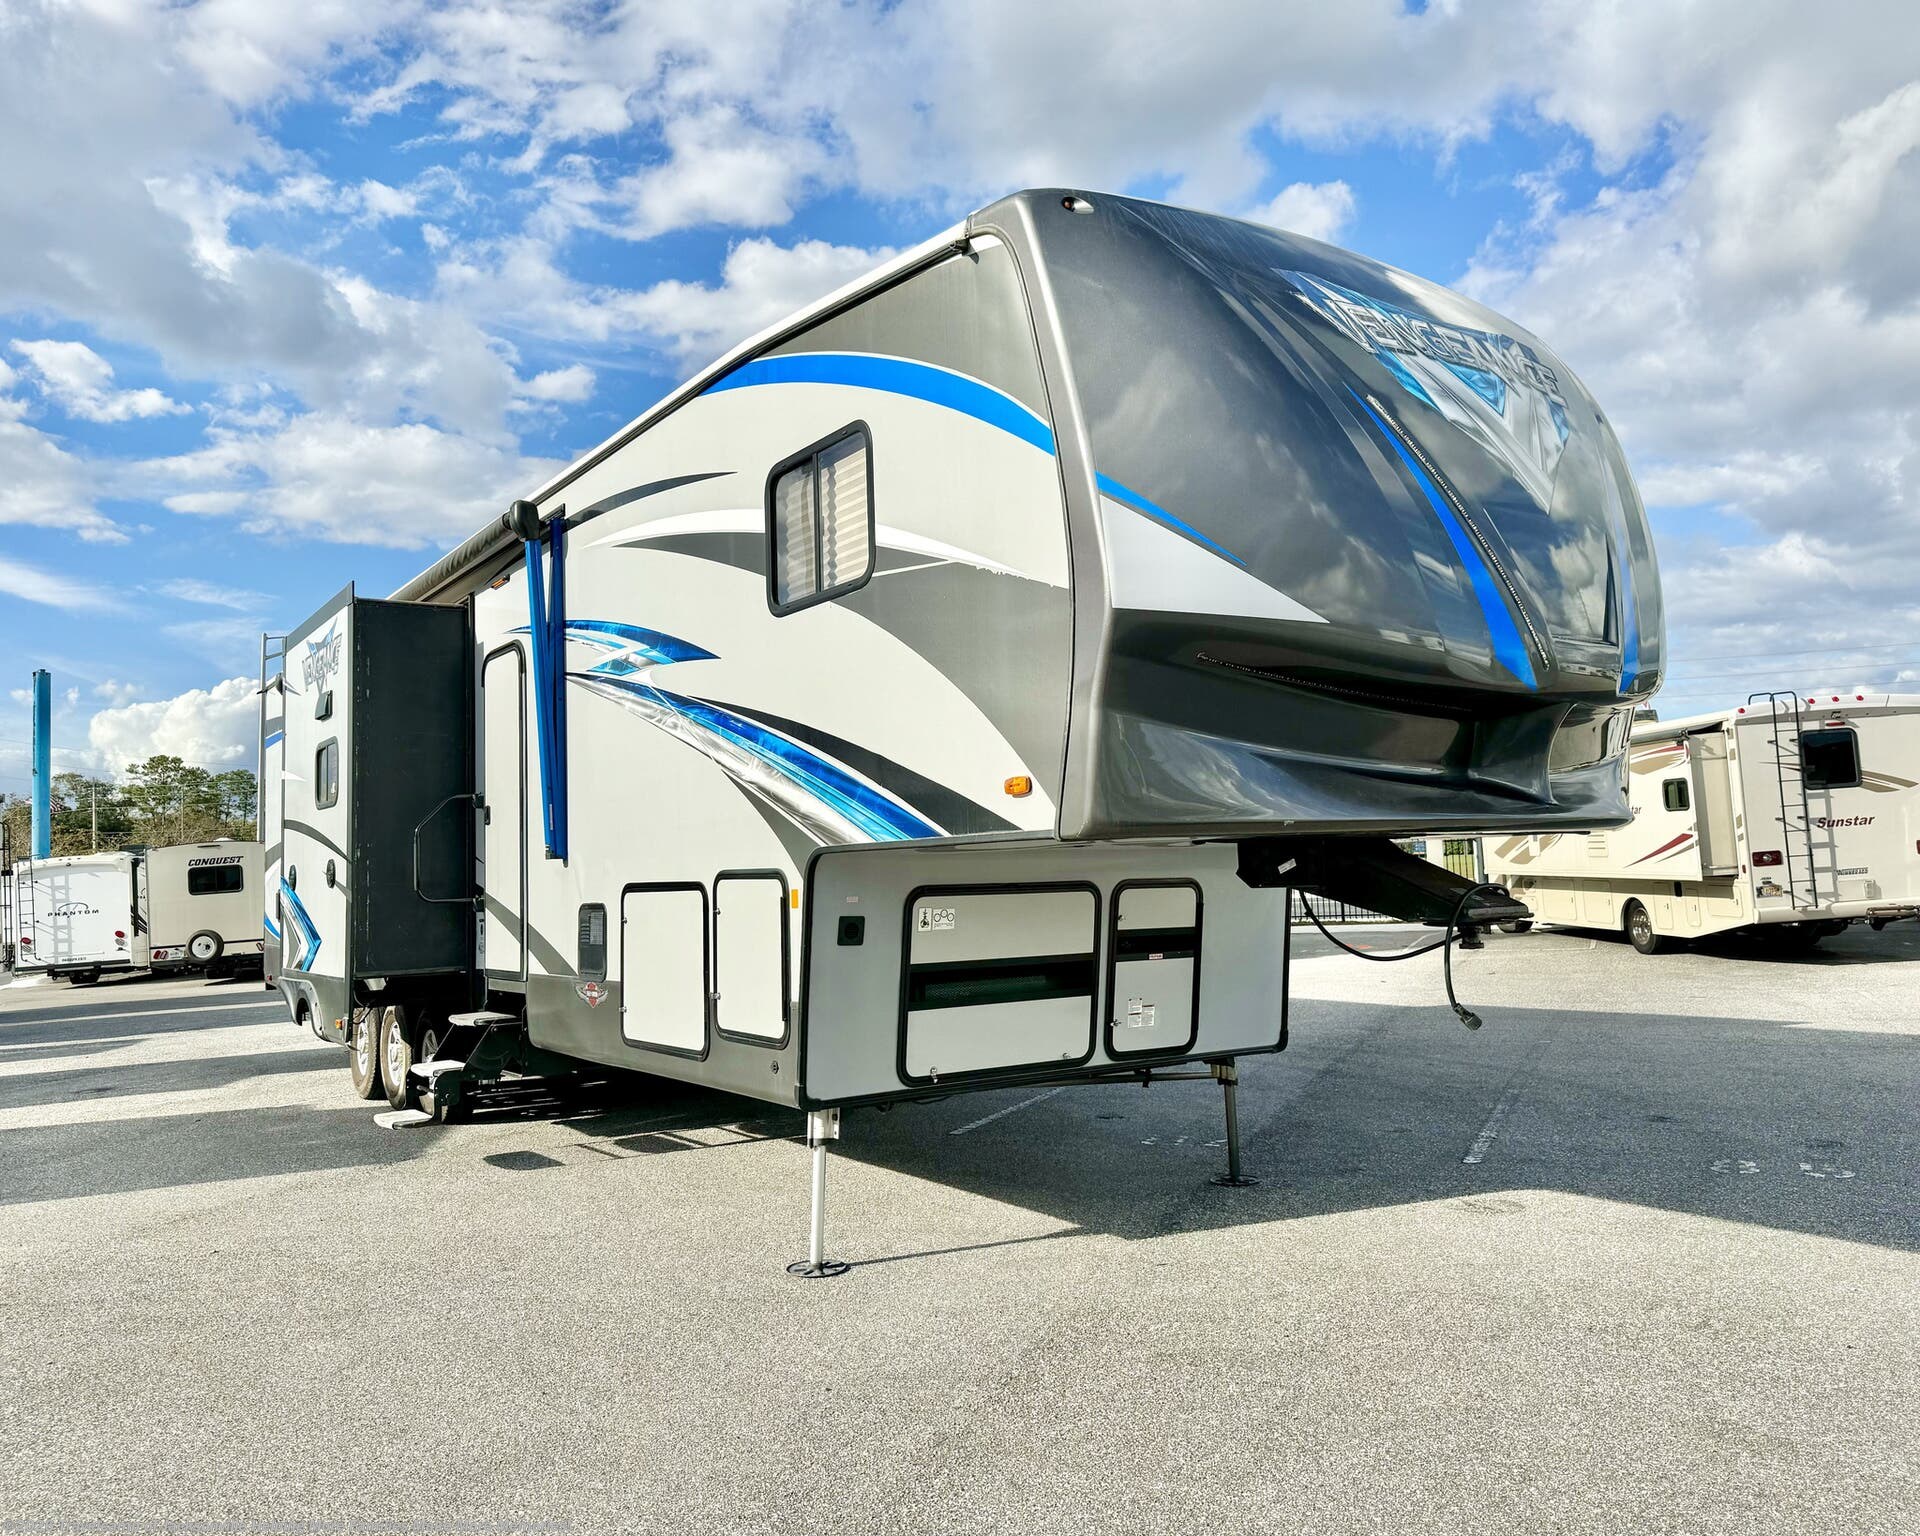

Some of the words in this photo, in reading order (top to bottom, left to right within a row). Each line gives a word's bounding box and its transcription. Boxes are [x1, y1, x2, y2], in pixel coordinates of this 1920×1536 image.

[1290, 291, 1567, 409] VENGEANCE
[1816, 815, 1875, 828] Sunstar
[188, 855, 244, 866] CONQUEST
[47, 909, 99, 918] PHANTOM
